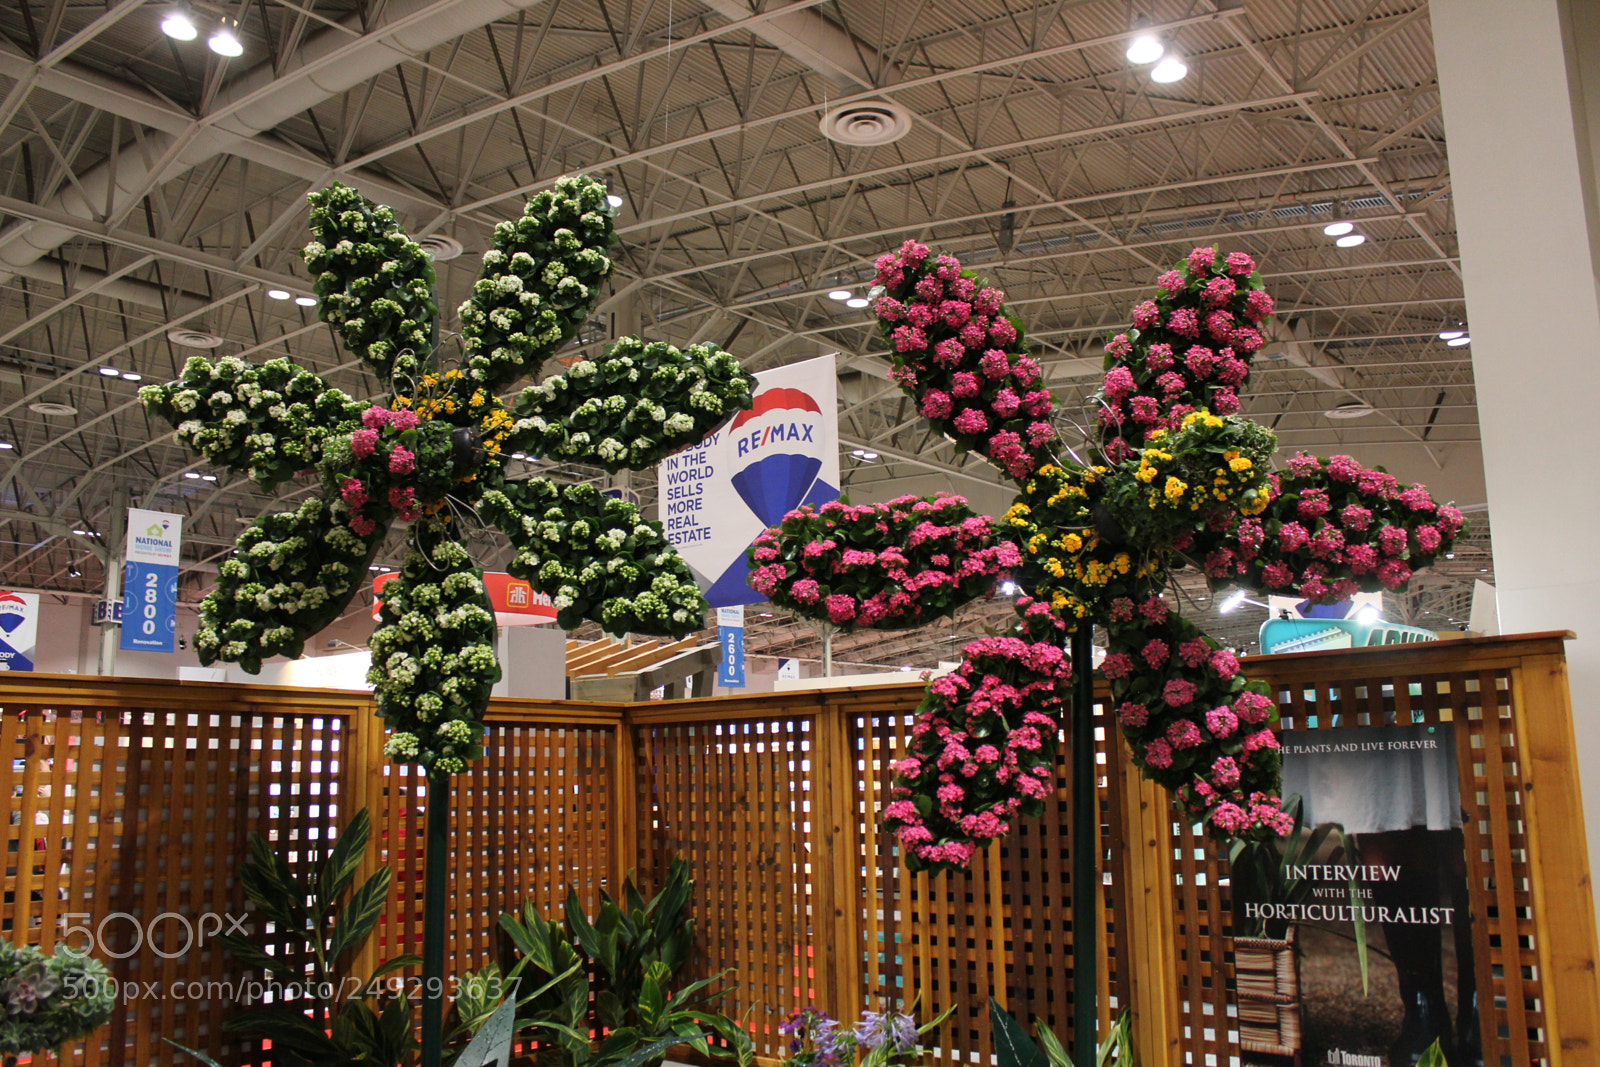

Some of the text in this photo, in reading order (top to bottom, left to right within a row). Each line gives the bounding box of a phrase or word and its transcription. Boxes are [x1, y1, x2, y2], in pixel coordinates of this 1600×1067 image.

[685, 433, 720, 452] ODY
[737, 422, 814, 458] RE/MAX
[667, 451, 707, 471] IN THE
[667, 465, 714, 485] WORLD
[667, 483, 704, 501] SELLS
[667, 498, 703, 516] MORE
[667, 514, 699, 531] REAL
[135, 536, 172, 548] NATIONAL
[668, 527, 711, 545] ESTATE
[0, 604, 24, 613] E/MAX
[142, 573, 158, 635] 2800
[727, 632, 736, 676] 2600
[1277, 740, 1438, 755] HE PLANTS AND LIVE FOREVER
[1285, 864, 1401, 882] INTERVIEW
[1312, 887, 1373, 899] WITH THE
[1244, 902, 1455, 925] HORTICULTURALIST
[1340, 1050, 1382, 1067] TORONTO
